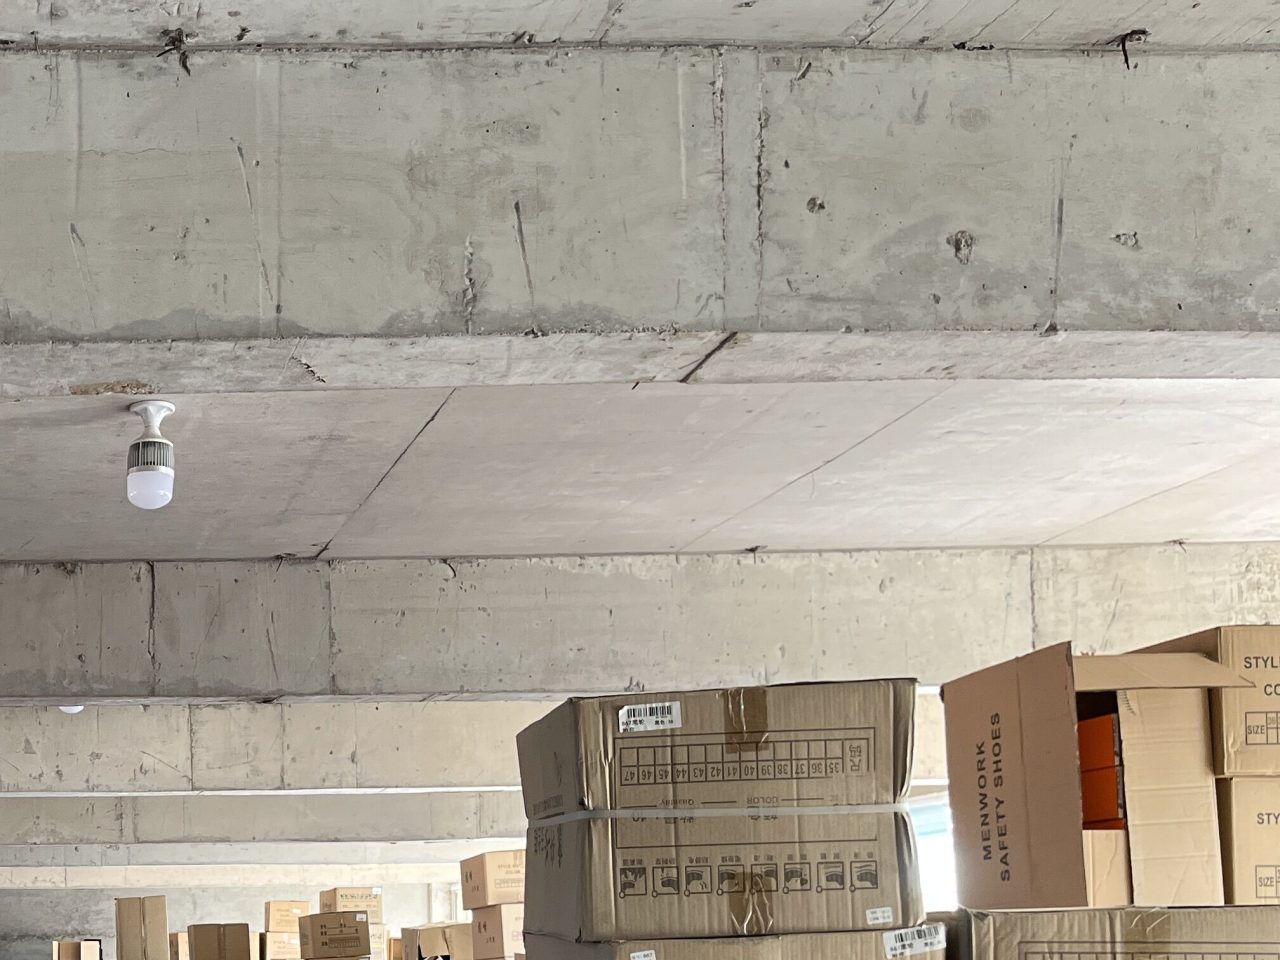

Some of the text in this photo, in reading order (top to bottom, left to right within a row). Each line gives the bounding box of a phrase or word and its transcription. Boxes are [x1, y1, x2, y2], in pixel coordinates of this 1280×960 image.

[1247, 725, 1264, 735] SIZE
[976, 741, 992, 860] MENWORK
[991, 712, 1010, 882] SAFETY SHOES
[1258, 876, 1274, 887] SIZE
